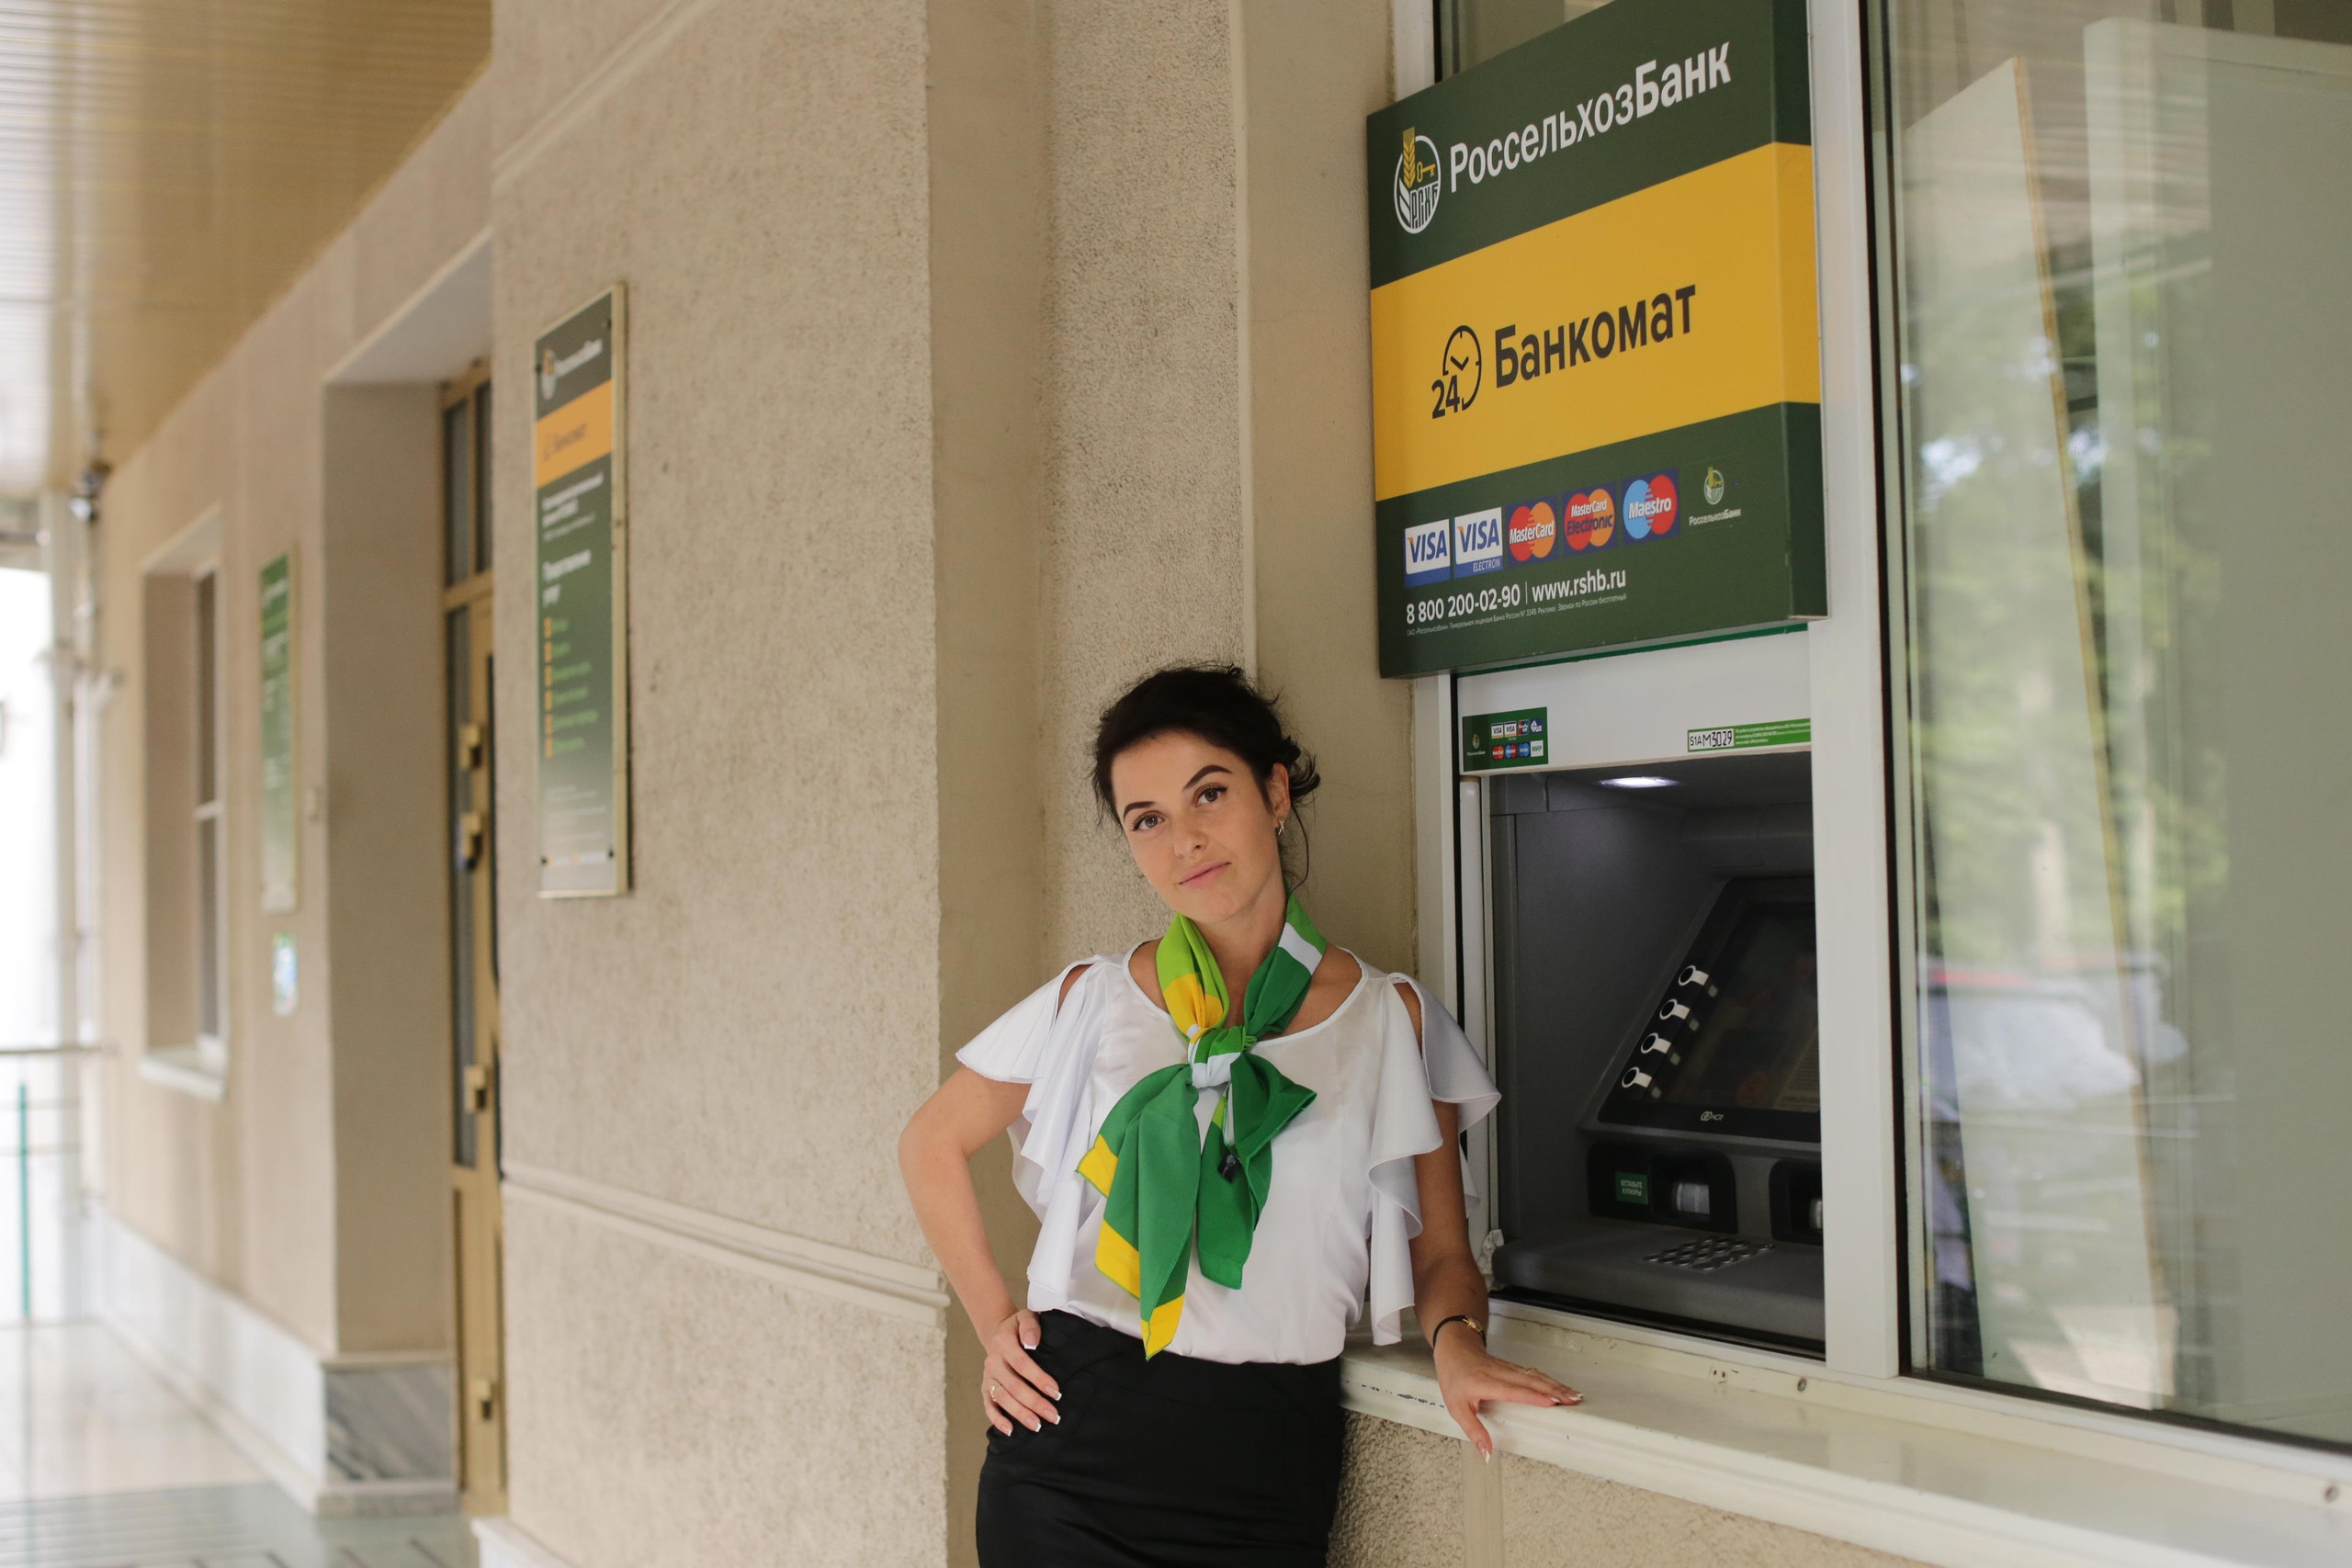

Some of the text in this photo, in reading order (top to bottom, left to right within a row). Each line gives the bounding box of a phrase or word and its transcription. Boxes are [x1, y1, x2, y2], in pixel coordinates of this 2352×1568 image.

[1450, 41, 1731, 193] РоссельхозБанк
[1495, 284, 1696, 389] Банкомат
[1431, 374, 1460, 419] 24
[1571, 499, 1607, 518] MasterCard
[1628, 497, 1672, 520] Maestro
[1689, 508, 1742, 525] РоссельхозБанк
[1456, 518, 1500, 553] VISA
[1510, 521, 1555, 545] MasterCard
[1566, 513, 1613, 536] Electronic
[1407, 530, 1448, 563] VISA
[1473, 558, 1500, 572] ELECTRON
[1406, 569, 1626, 625] 8 800 200-02-90 www.rshb.ru
